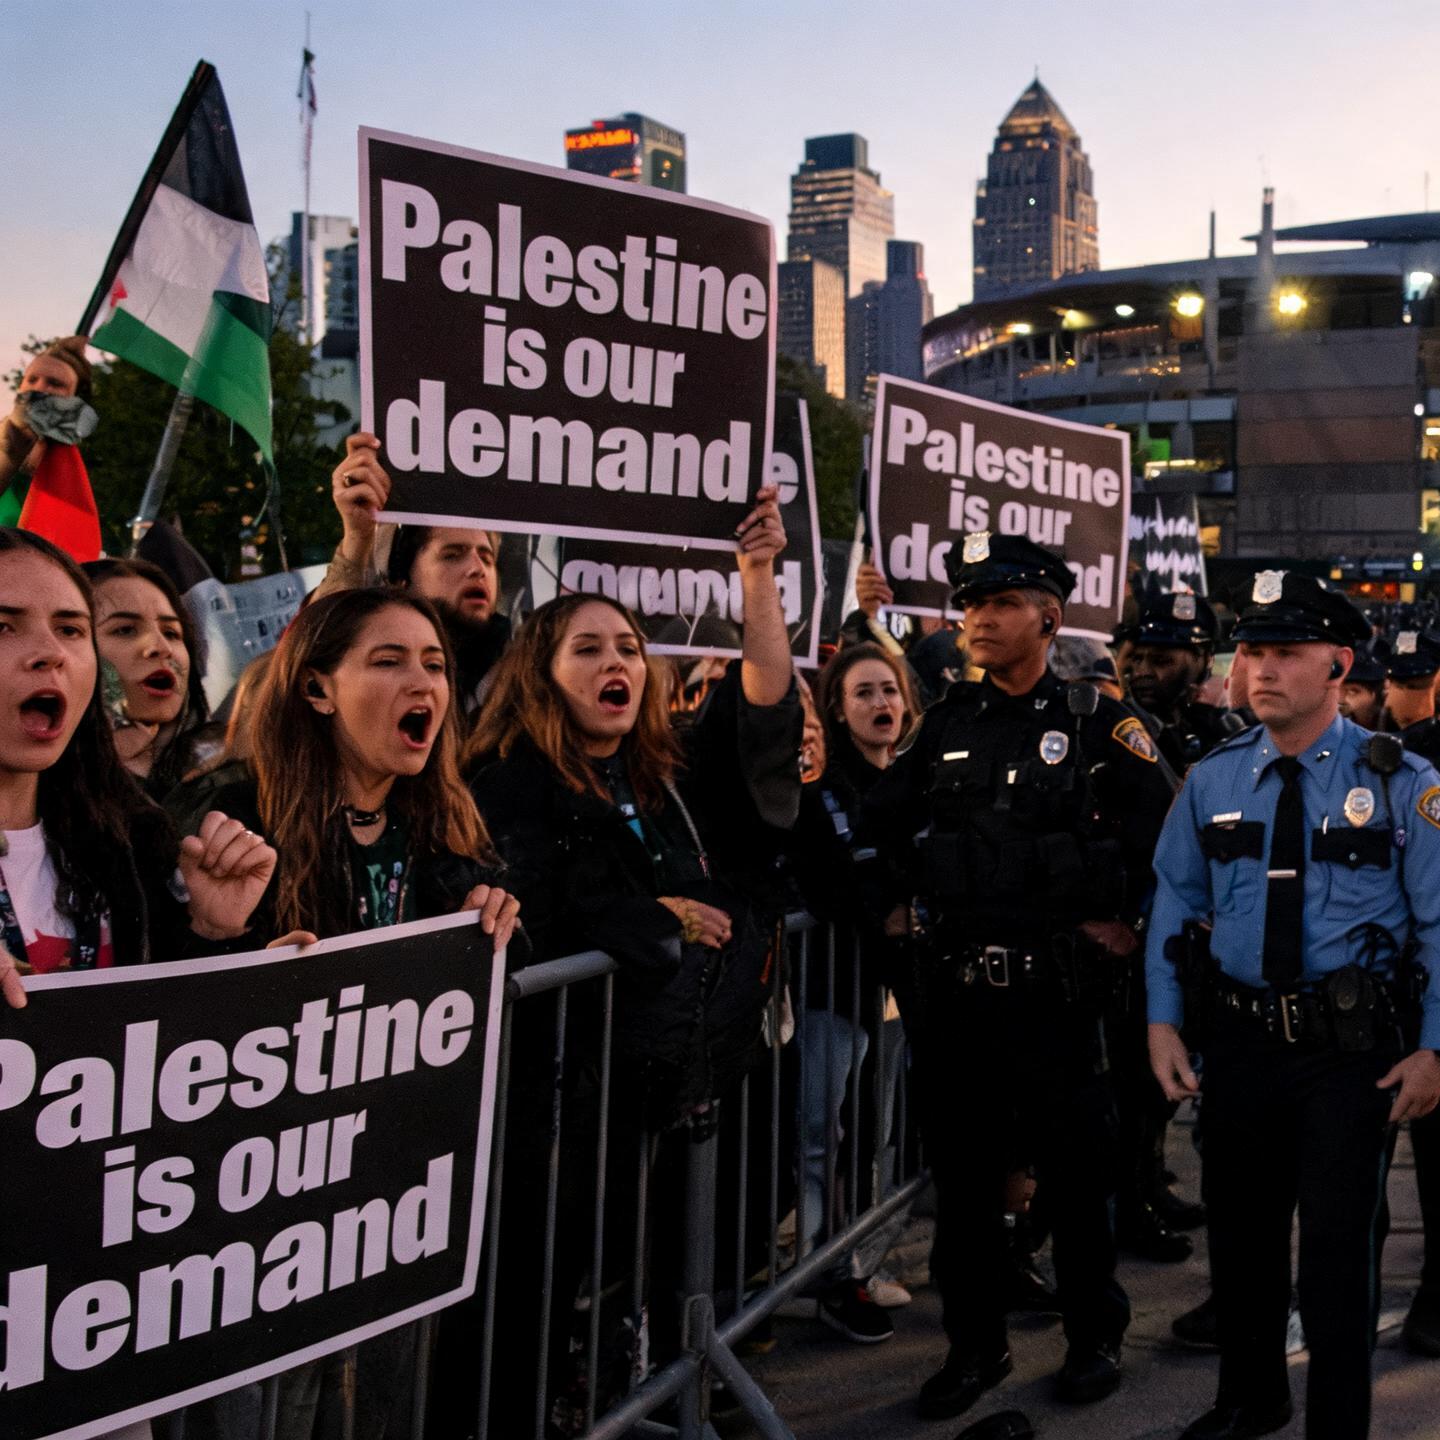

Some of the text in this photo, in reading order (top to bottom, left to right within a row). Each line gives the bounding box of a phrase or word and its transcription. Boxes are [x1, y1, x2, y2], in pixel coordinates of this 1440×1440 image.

[382, 179, 767, 340] Palestine
[484, 306, 685, 408] is our
[386, 379, 751, 503] demand
[887, 404, 1121, 508] Palestine
[949, 478, 989, 533] is
[999, 501, 1073, 546] our
[103, 1109, 366, 1248] is our
